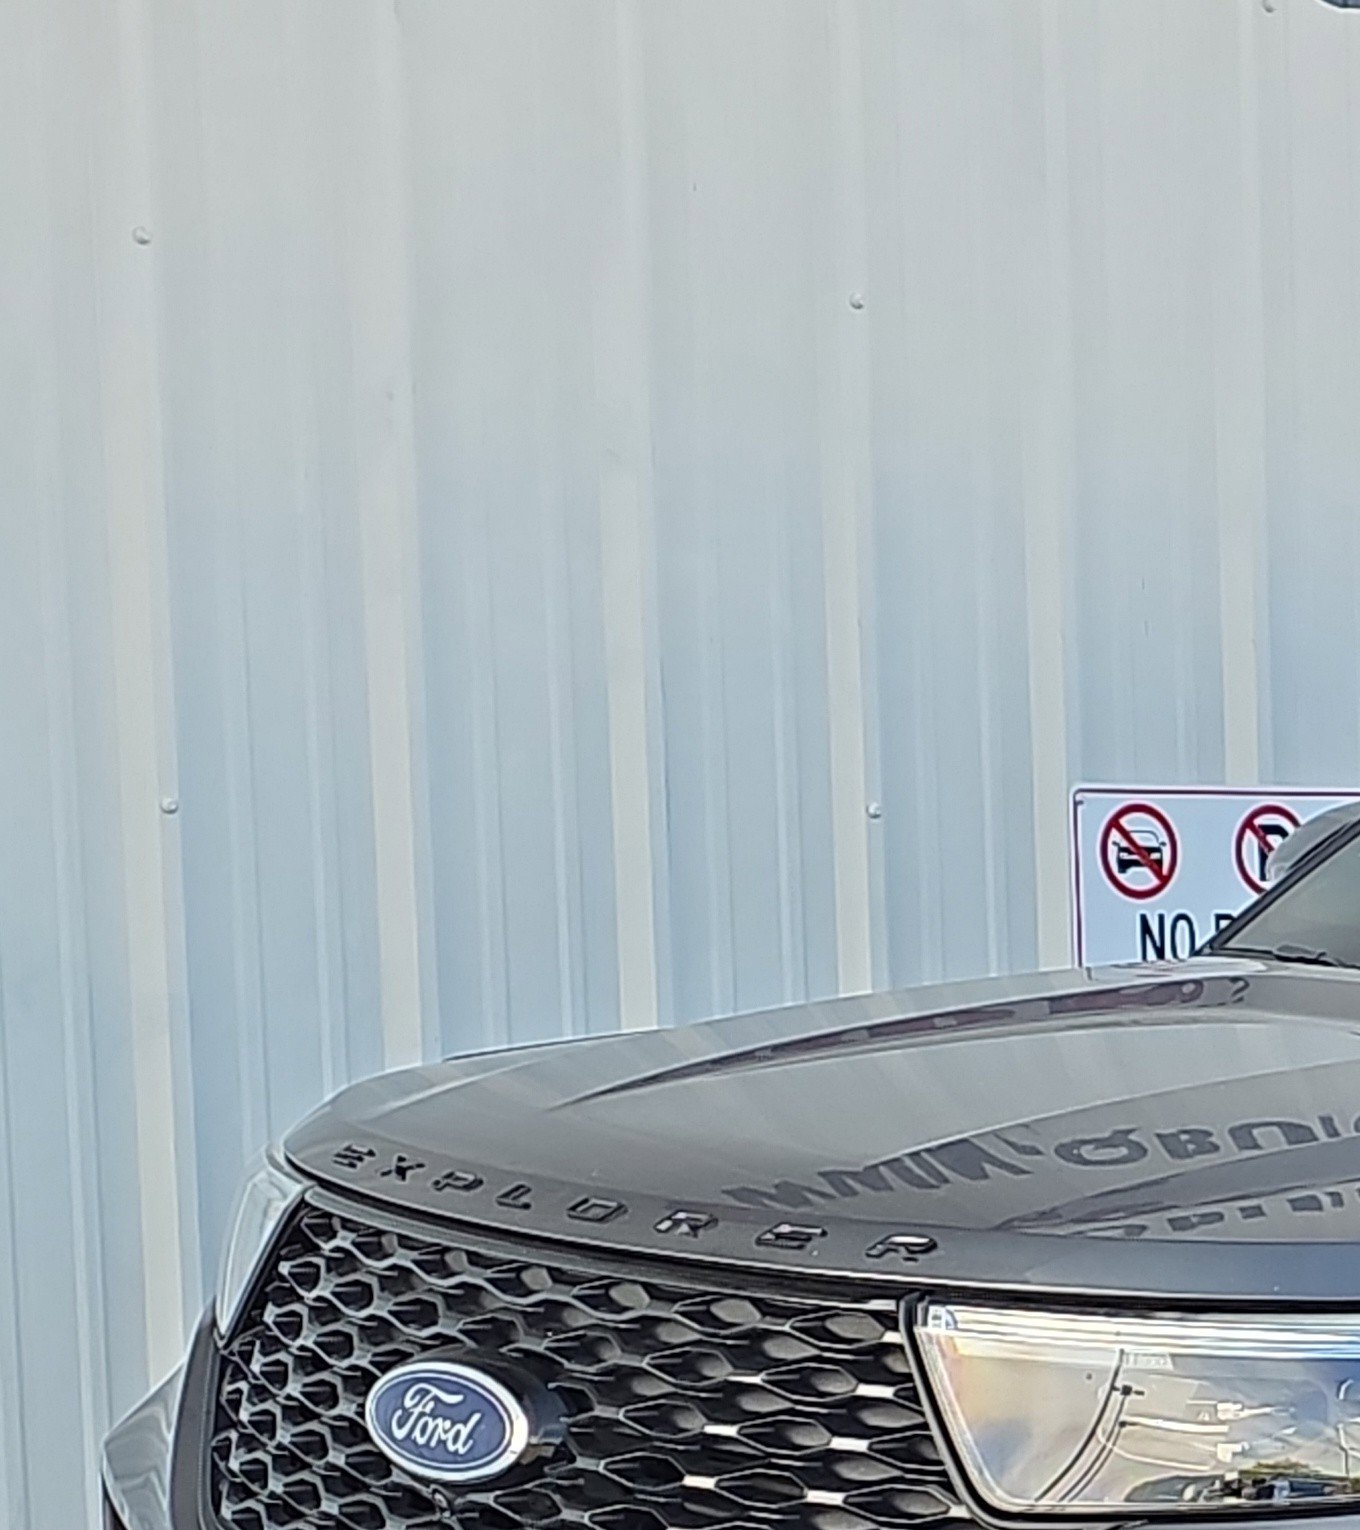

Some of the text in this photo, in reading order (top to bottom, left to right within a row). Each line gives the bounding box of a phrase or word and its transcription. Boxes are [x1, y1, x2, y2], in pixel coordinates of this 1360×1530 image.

[1139, 912, 1196, 962] NO
[329, 1141, 945, 1266] EXPLORER
[391, 1382, 476, 1455] Ford
